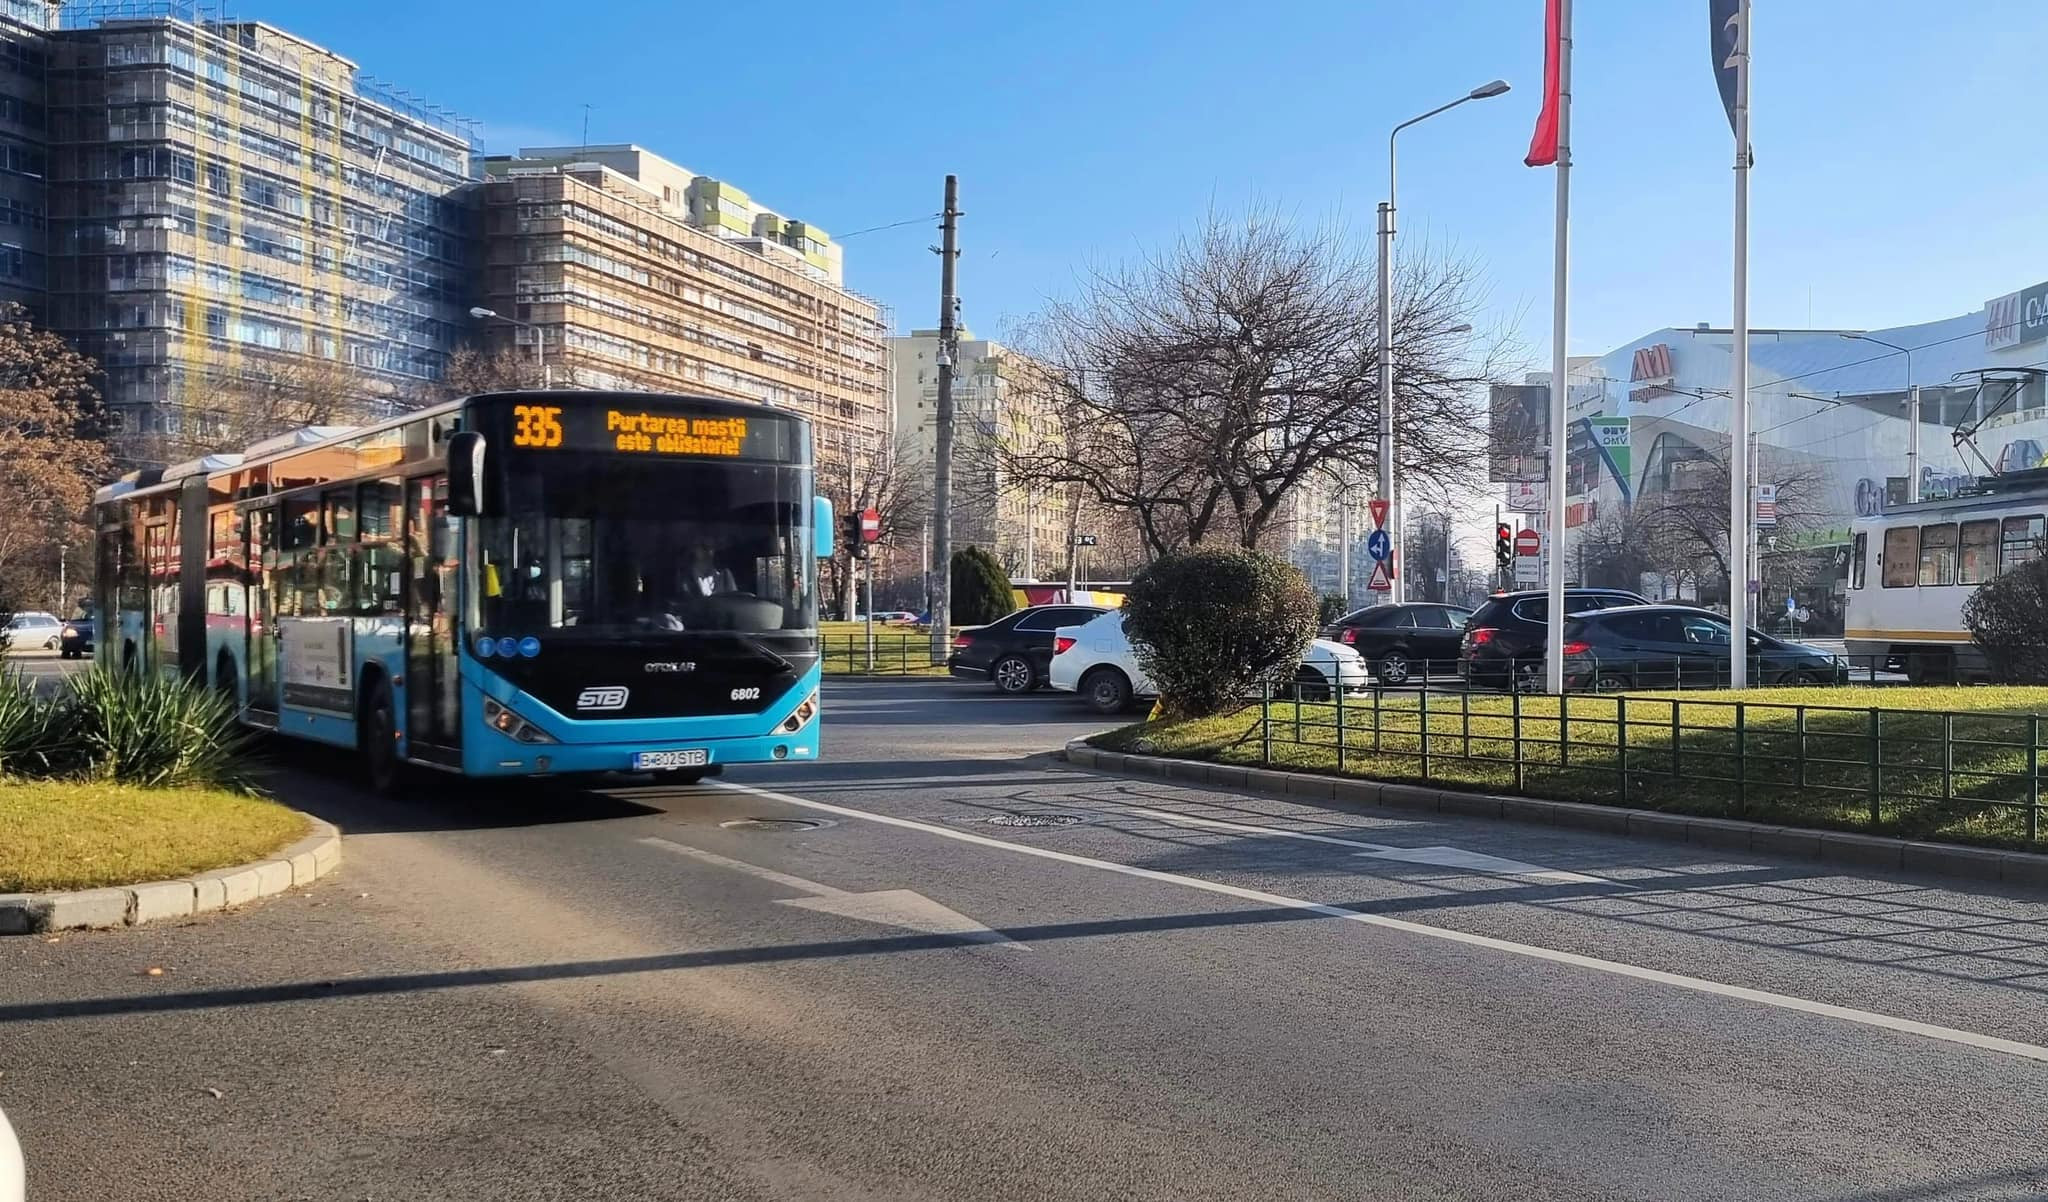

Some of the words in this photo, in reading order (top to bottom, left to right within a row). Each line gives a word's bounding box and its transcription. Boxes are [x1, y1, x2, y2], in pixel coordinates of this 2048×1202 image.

[514, 405, 563, 448] 335
[607, 410, 688, 435] Purtarea
[616, 432, 652, 451] este
[577, 688, 627, 708] STB
[730, 687, 760, 701] 6802
